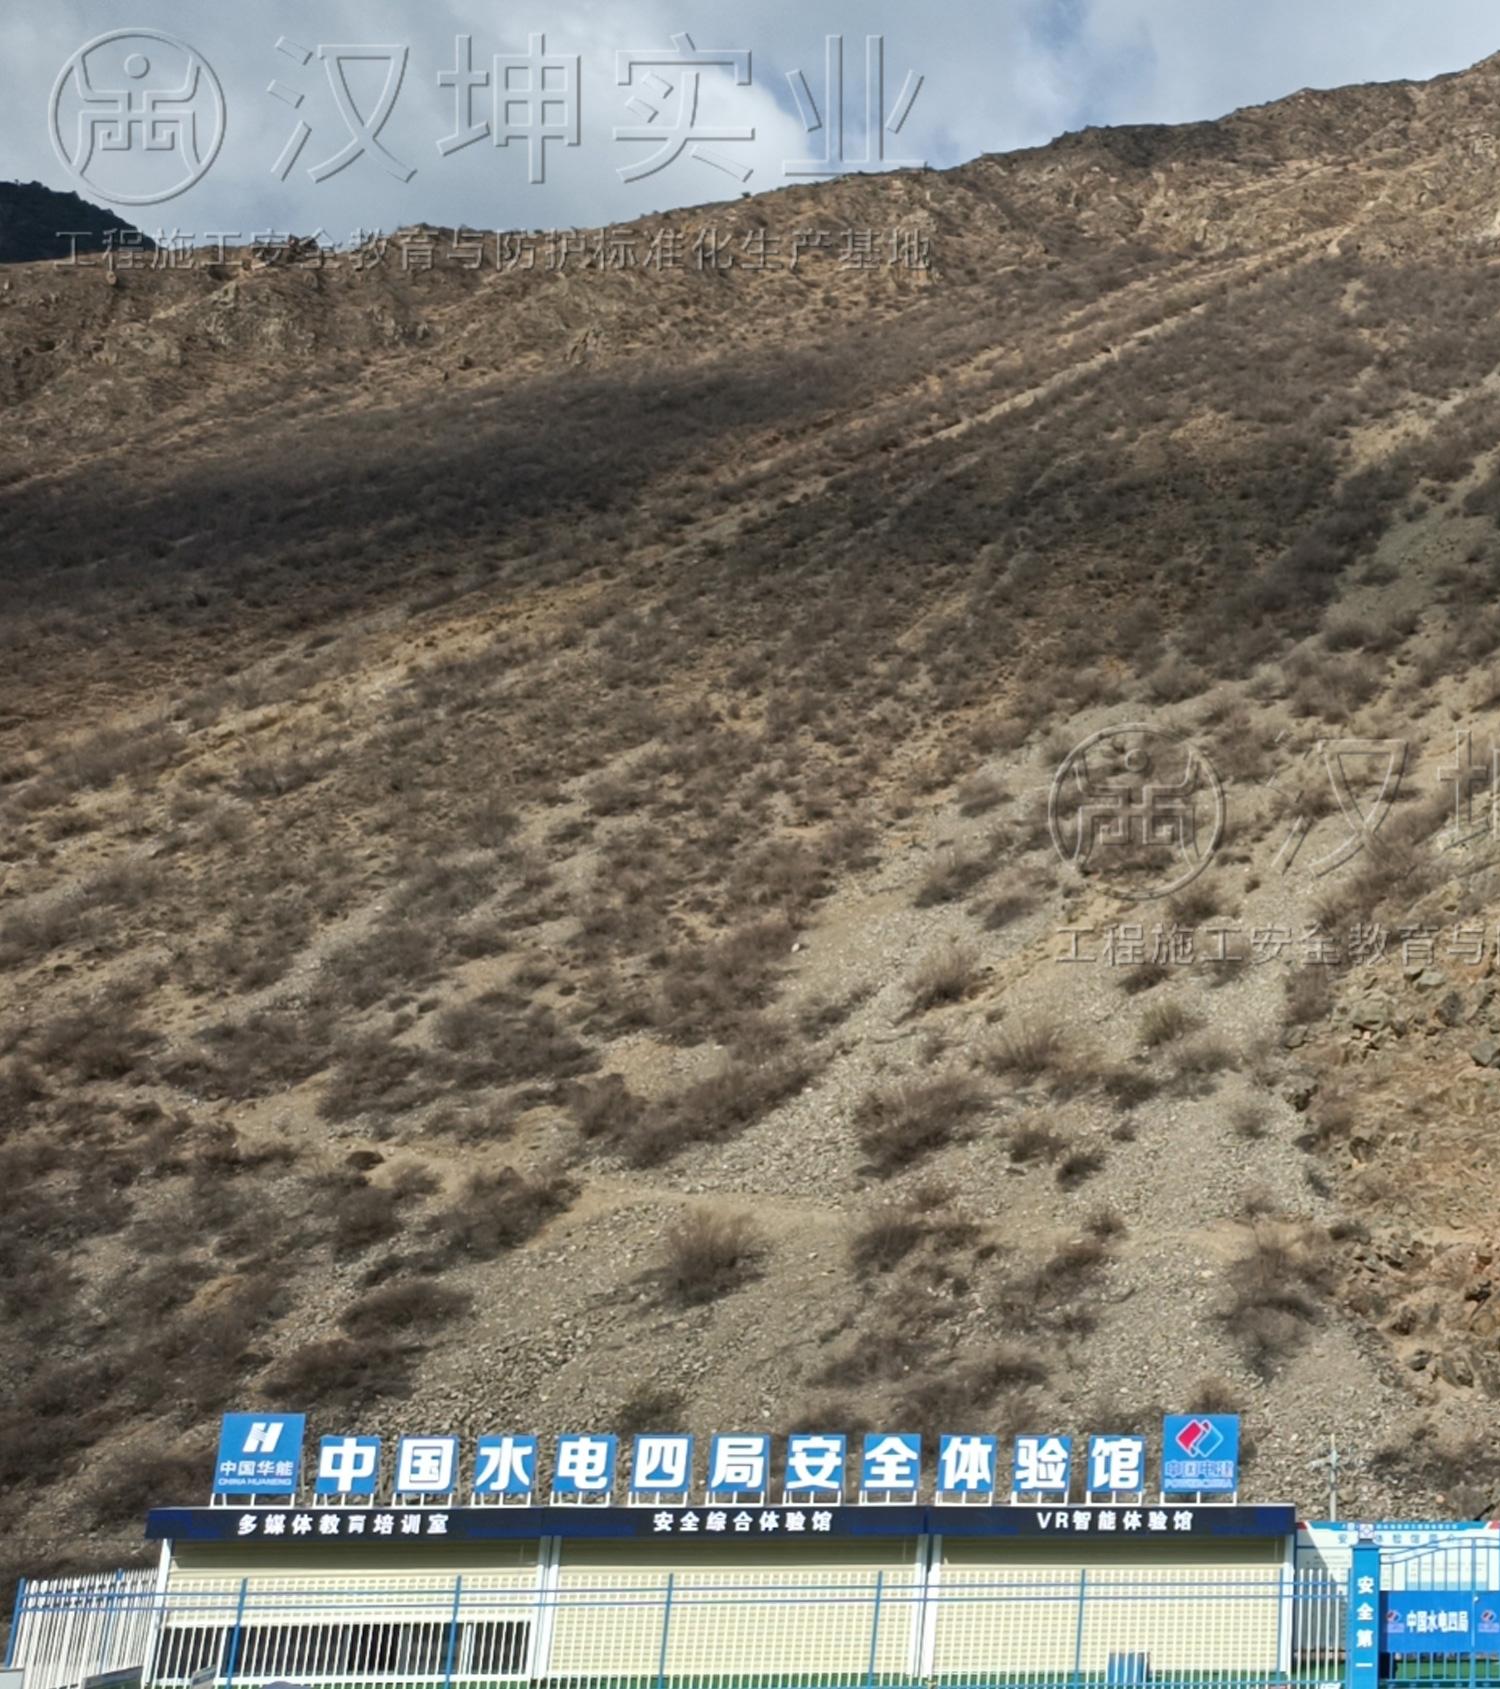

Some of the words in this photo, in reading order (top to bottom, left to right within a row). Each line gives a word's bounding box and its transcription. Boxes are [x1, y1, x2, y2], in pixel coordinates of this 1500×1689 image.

[220, 1460, 294, 1476] 中国华能
[319, 1436, 1142, 1491] 中国水电四局安全体验馆
[237, 1513, 449, 1536] 多媒体教育培训室
[653, 1511, 834, 1533] 安全综合体验馆
[1037, 1511, 1194, 1532] VR智能体验馆
[1355, 1576, 1374, 1667] 安全第一
[1407, 1609, 1469, 1633] 中国水电四局
